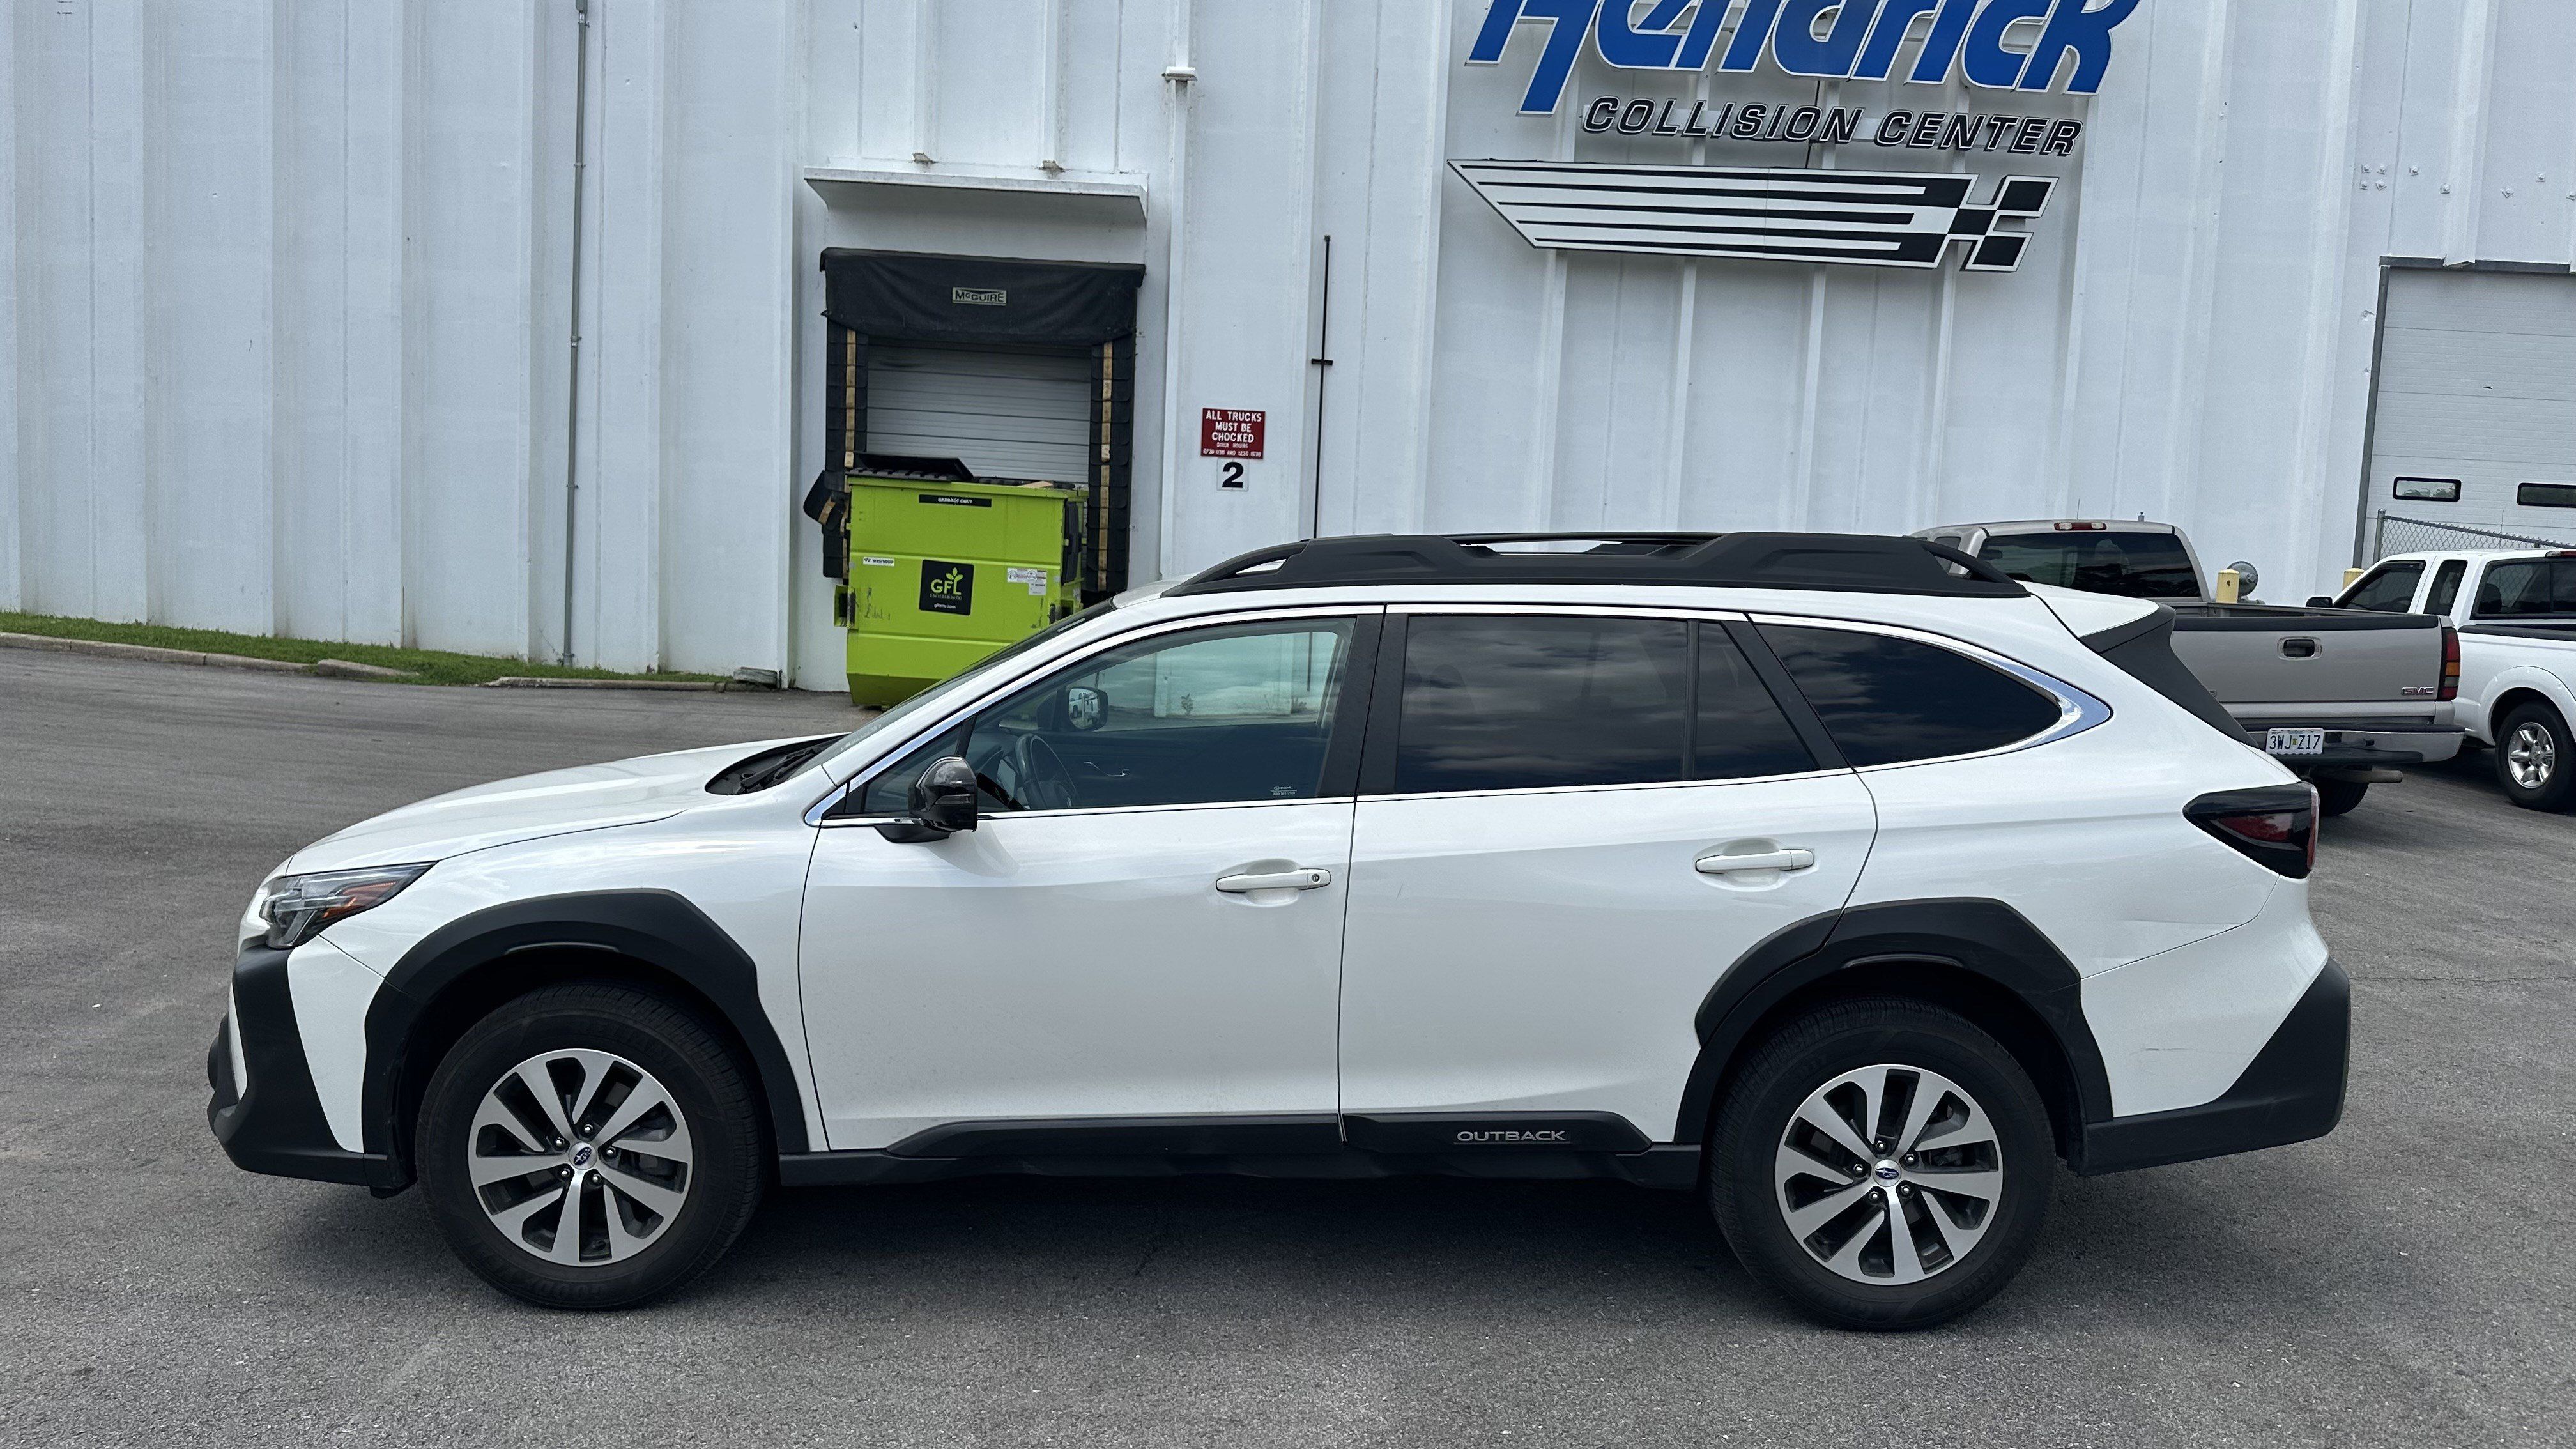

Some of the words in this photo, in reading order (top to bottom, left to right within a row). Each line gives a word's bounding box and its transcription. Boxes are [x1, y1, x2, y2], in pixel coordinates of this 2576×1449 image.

[1581, 96, 1864, 145] COLLISION
[1874, 109, 2084, 156] CENTER
[1206, 410, 1222, 420] ALL
[1227, 411, 1262, 422] TRUCKS
[1215, 421, 1238, 431] MUST
[1241, 422, 1252, 432] BE
[1211, 431, 1254, 443] CHOCKED
[1222, 461, 1243, 488] 2
[931, 574, 963, 595] GFL
[2402, 686, 2434, 695] GMC
[1457, 1131, 1566, 1142] OUTBACK
